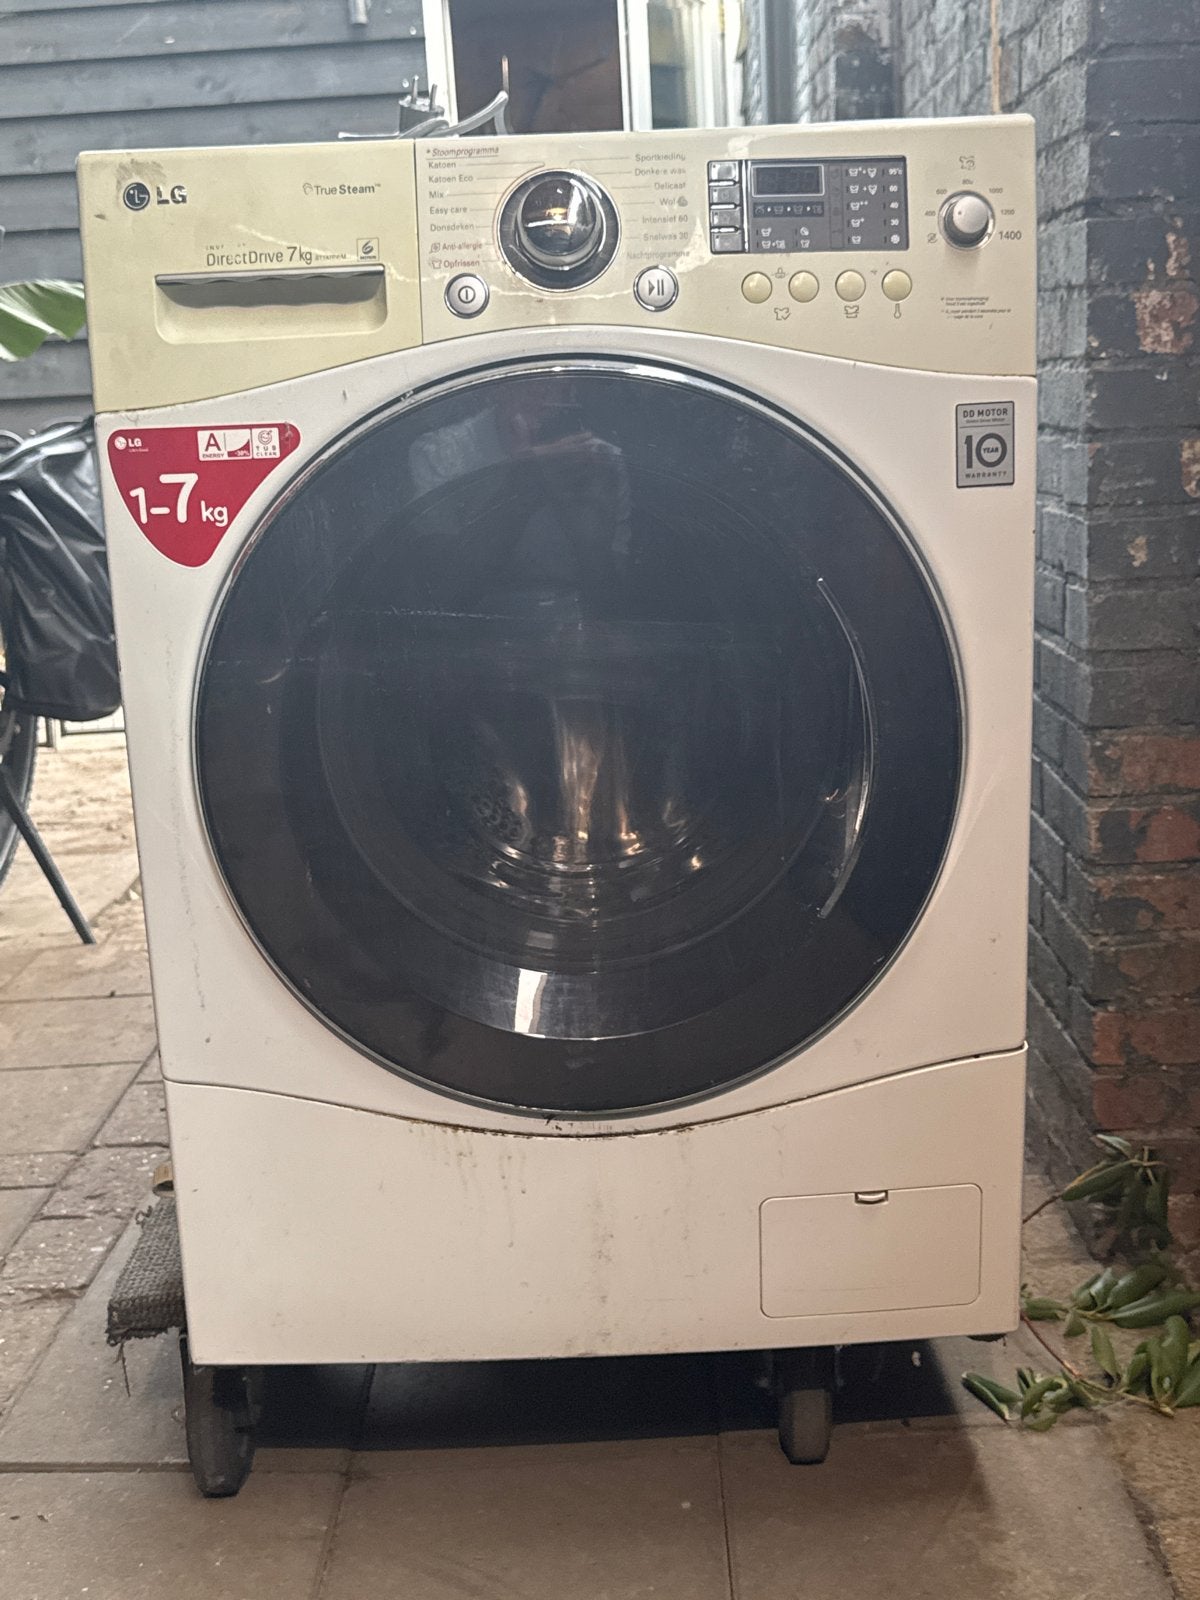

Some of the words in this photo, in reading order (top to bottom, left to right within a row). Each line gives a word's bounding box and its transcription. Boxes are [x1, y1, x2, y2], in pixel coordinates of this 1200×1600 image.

[432, 147, 499, 157] Stoomprogramma
[428, 175, 456, 183] Katoen
[458, 174, 474, 182] Eco
[156, 185, 187, 205] LG
[429, 190, 444, 199] Mix
[430, 206, 448, 215] Easy
[678, 213, 689, 222] 60
[678, 231, 689, 240] 30
[998, 230, 1023, 240] 1400
[286, 246, 298, 262] 7
[299, 244, 312, 266] kg
[443, 259, 480, 269] Opfrissen
[962, 410, 975, 418] DD
[977, 408, 1008, 417] MOTOR
[127, 437, 143, 448] LG
[204, 432, 222, 452] A
[963, 432, 1008, 469] 10
[982, 446, 1000, 454] YEAR
[964, 471, 1008, 479] WARRANTY
[200, 500, 229, 528] kg
